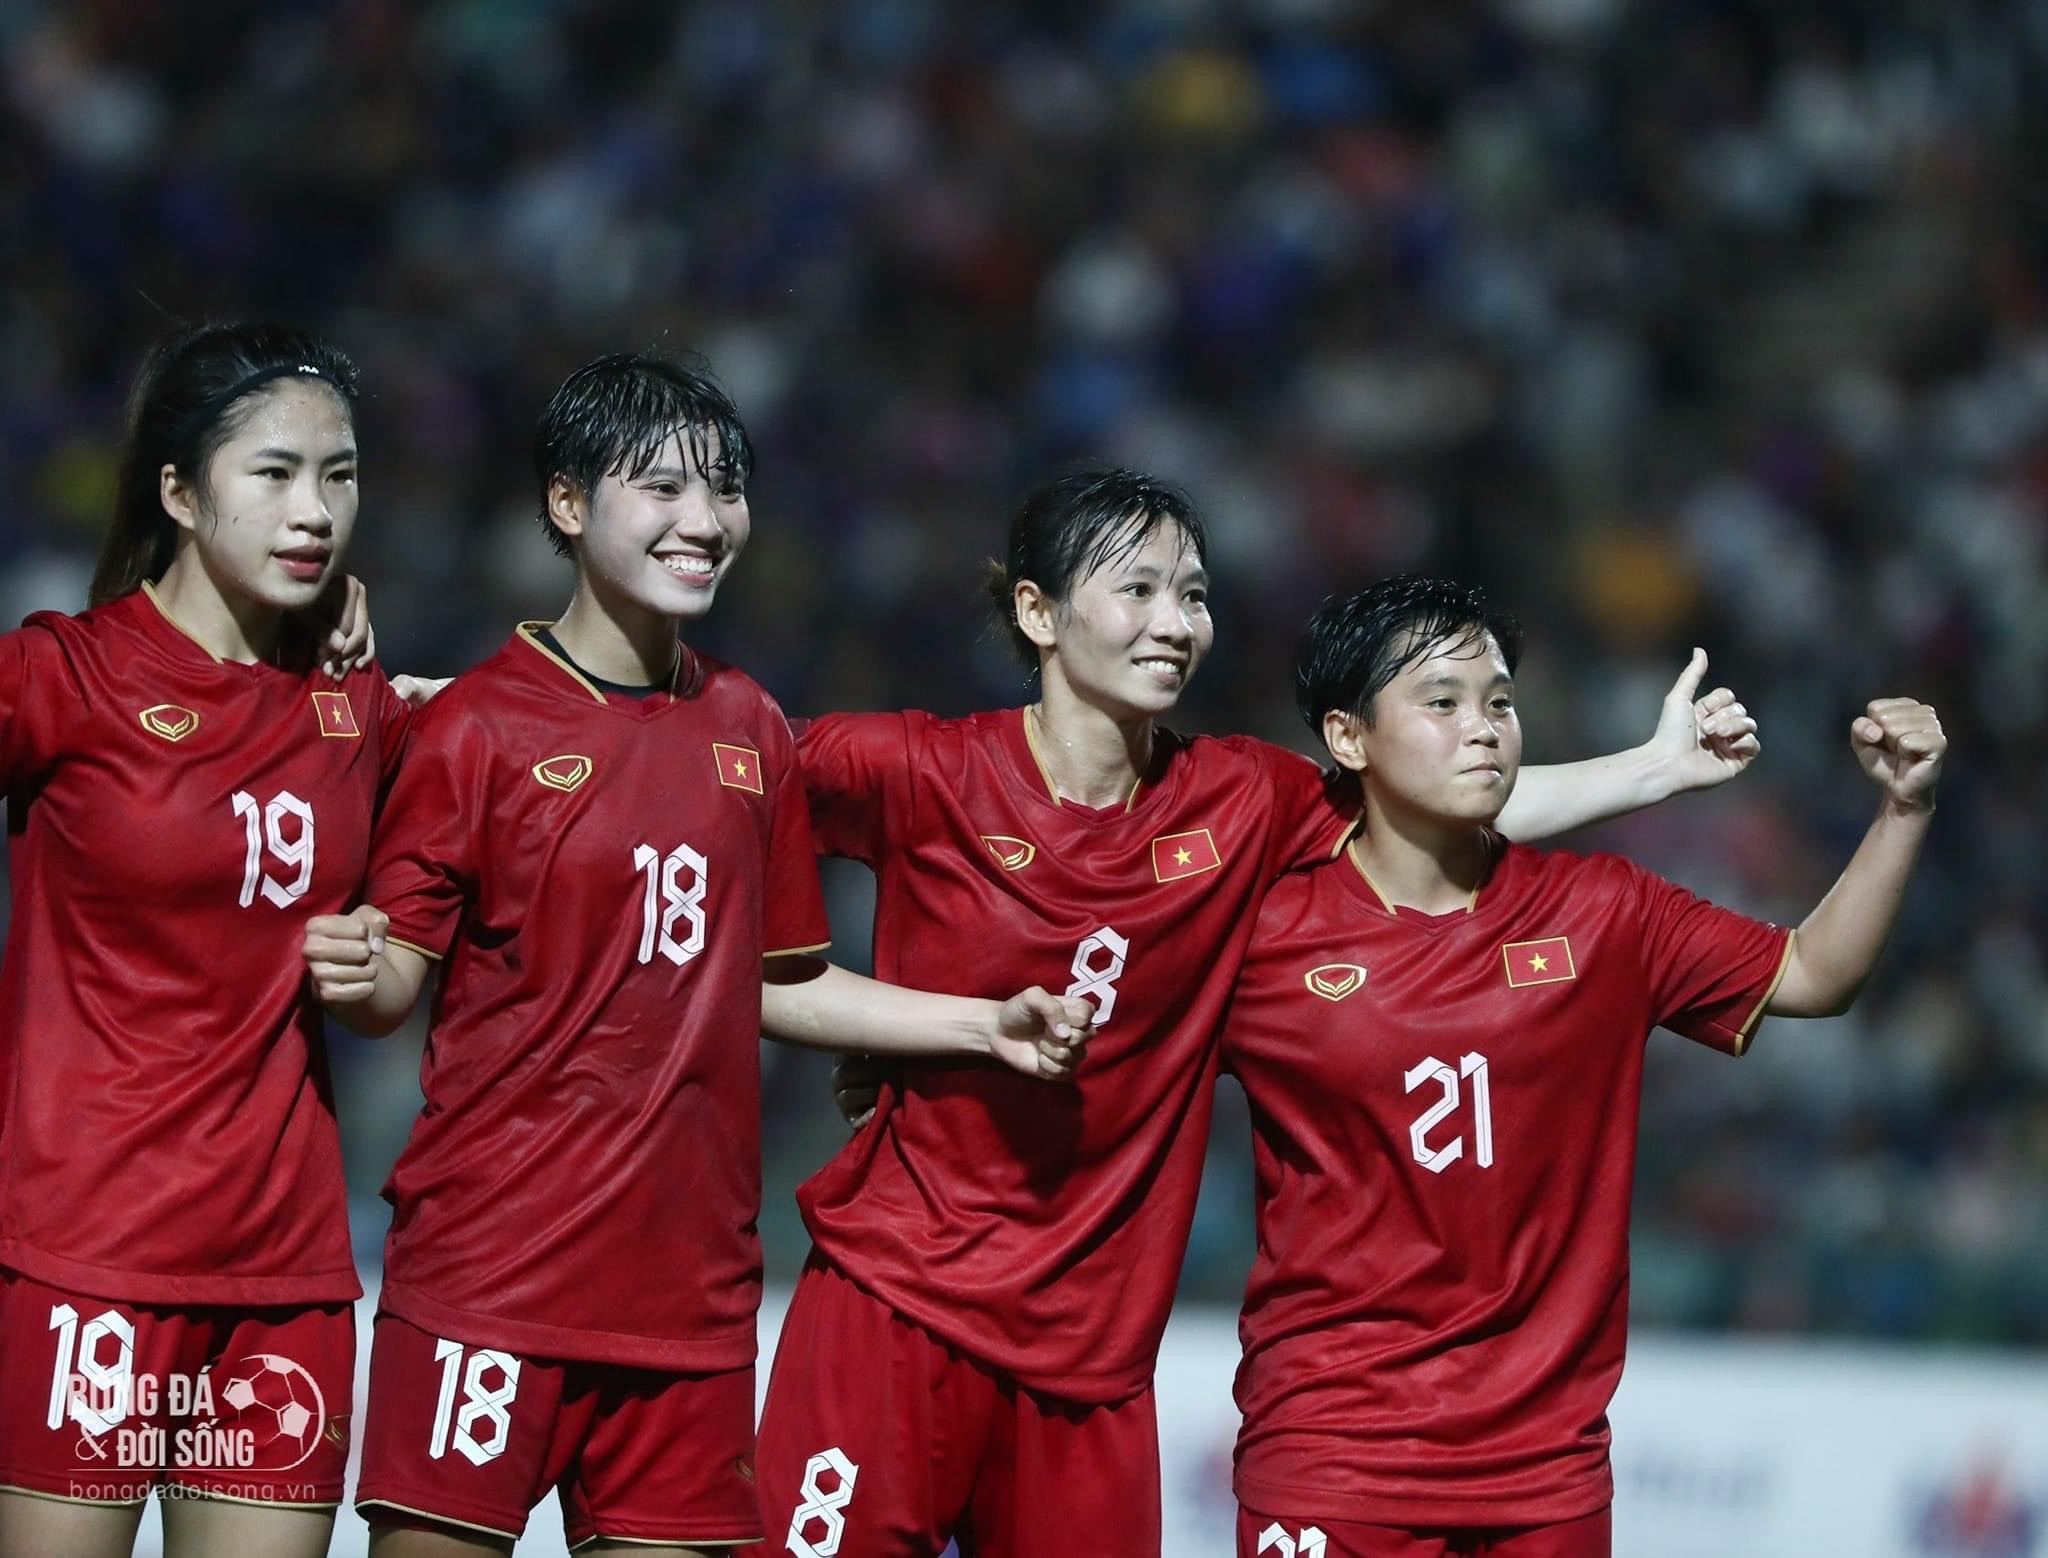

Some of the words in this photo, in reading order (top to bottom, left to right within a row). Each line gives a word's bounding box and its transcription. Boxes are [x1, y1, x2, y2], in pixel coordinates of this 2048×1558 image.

[231, 790, 314, 909] 19
[633, 843, 708, 966] 18
[1064, 926, 1130, 1028] 8
[1405, 1051, 1493, 1174] 21
[47, 1303, 135, 1437] 19
[429, 1339, 521, 1466] 18
[785, 1447, 859, 1558] 8
